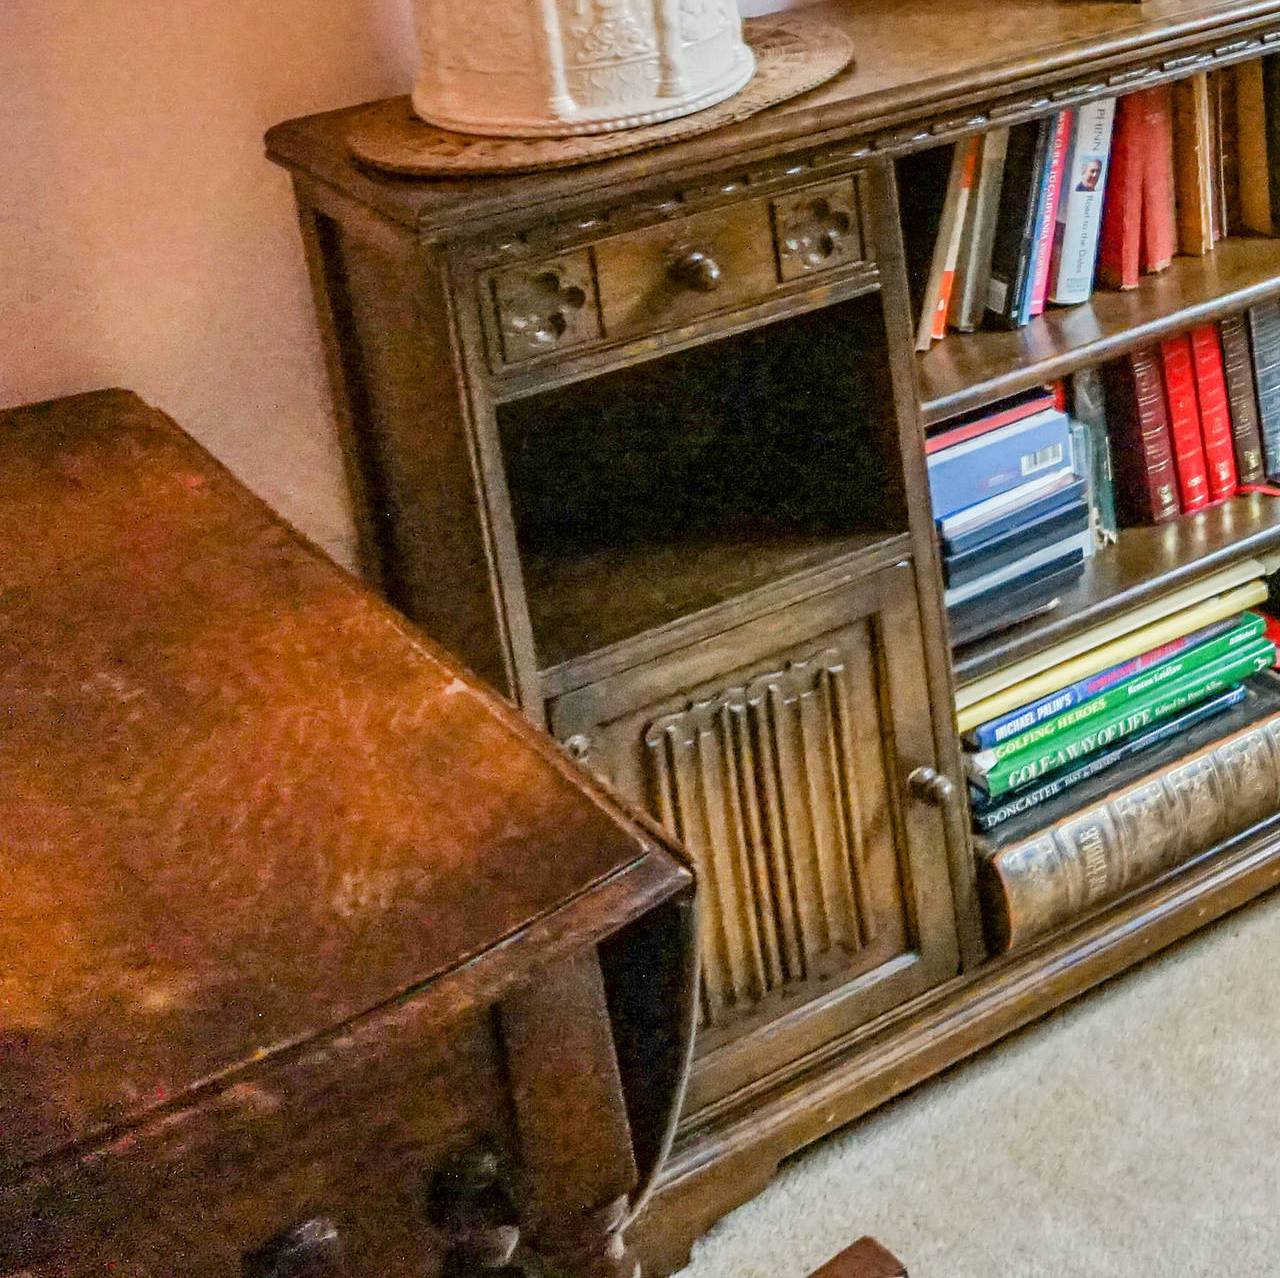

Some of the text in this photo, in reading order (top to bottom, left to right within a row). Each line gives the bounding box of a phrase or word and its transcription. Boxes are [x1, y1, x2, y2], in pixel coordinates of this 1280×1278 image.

[1093, 108, 1106, 152] PHINN
[1039, 184, 1056, 241] CALIFORNIA
[1084, 195, 1094, 219] Road
[995, 692, 1072, 742] MICHAEL PALIN'S
[996, 698, 1107, 758] GOLFING HEROES
[1066, 734, 1096, 761] WAY
[1097, 725, 1118, 747] OF
[1118, 708, 1152, 737] LIFE
[986, 782, 1061, 828] DONCASTER
